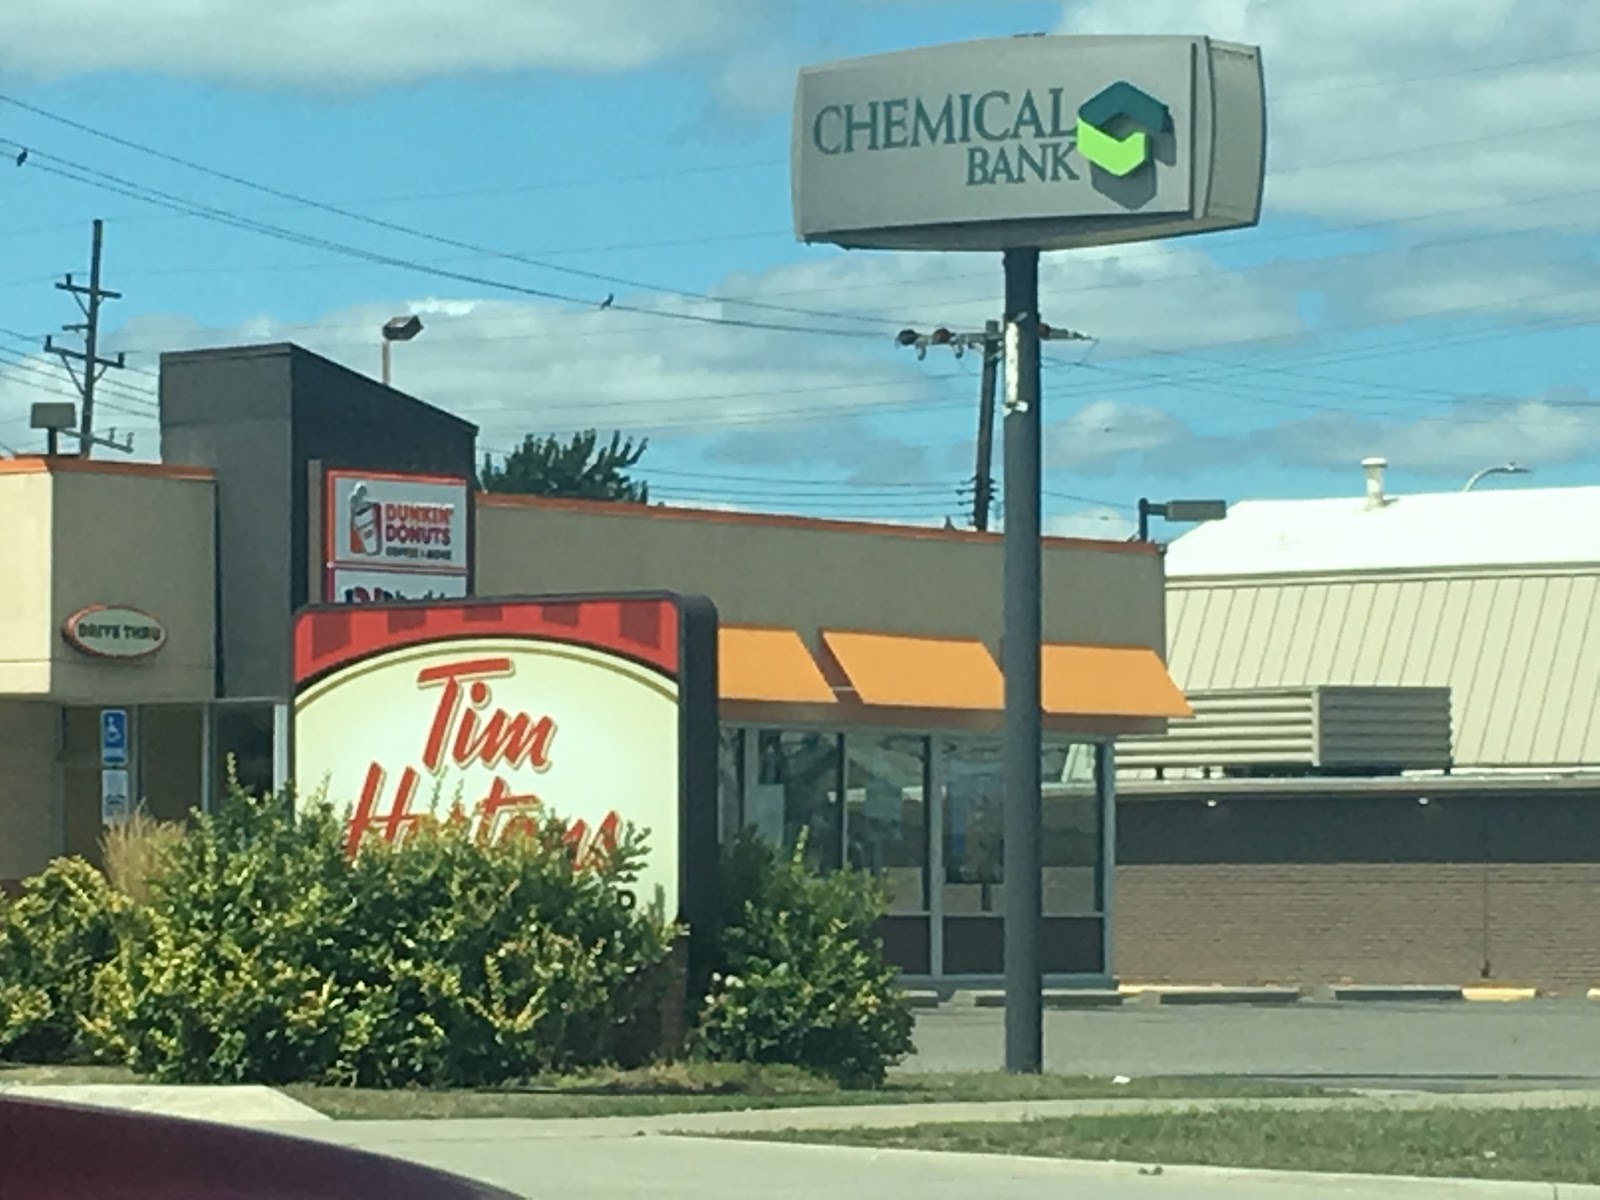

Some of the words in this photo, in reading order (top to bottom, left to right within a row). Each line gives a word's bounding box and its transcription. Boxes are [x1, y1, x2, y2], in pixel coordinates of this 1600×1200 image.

[813, 87, 1079, 155] CHEMICAL
[965, 141, 1080, 187] BANK
[385, 523, 451, 546] DONUTS
[78, 623, 120, 639] DRIVE
[123, 625, 161, 642] THRU
[418, 657, 557, 774] Tim
